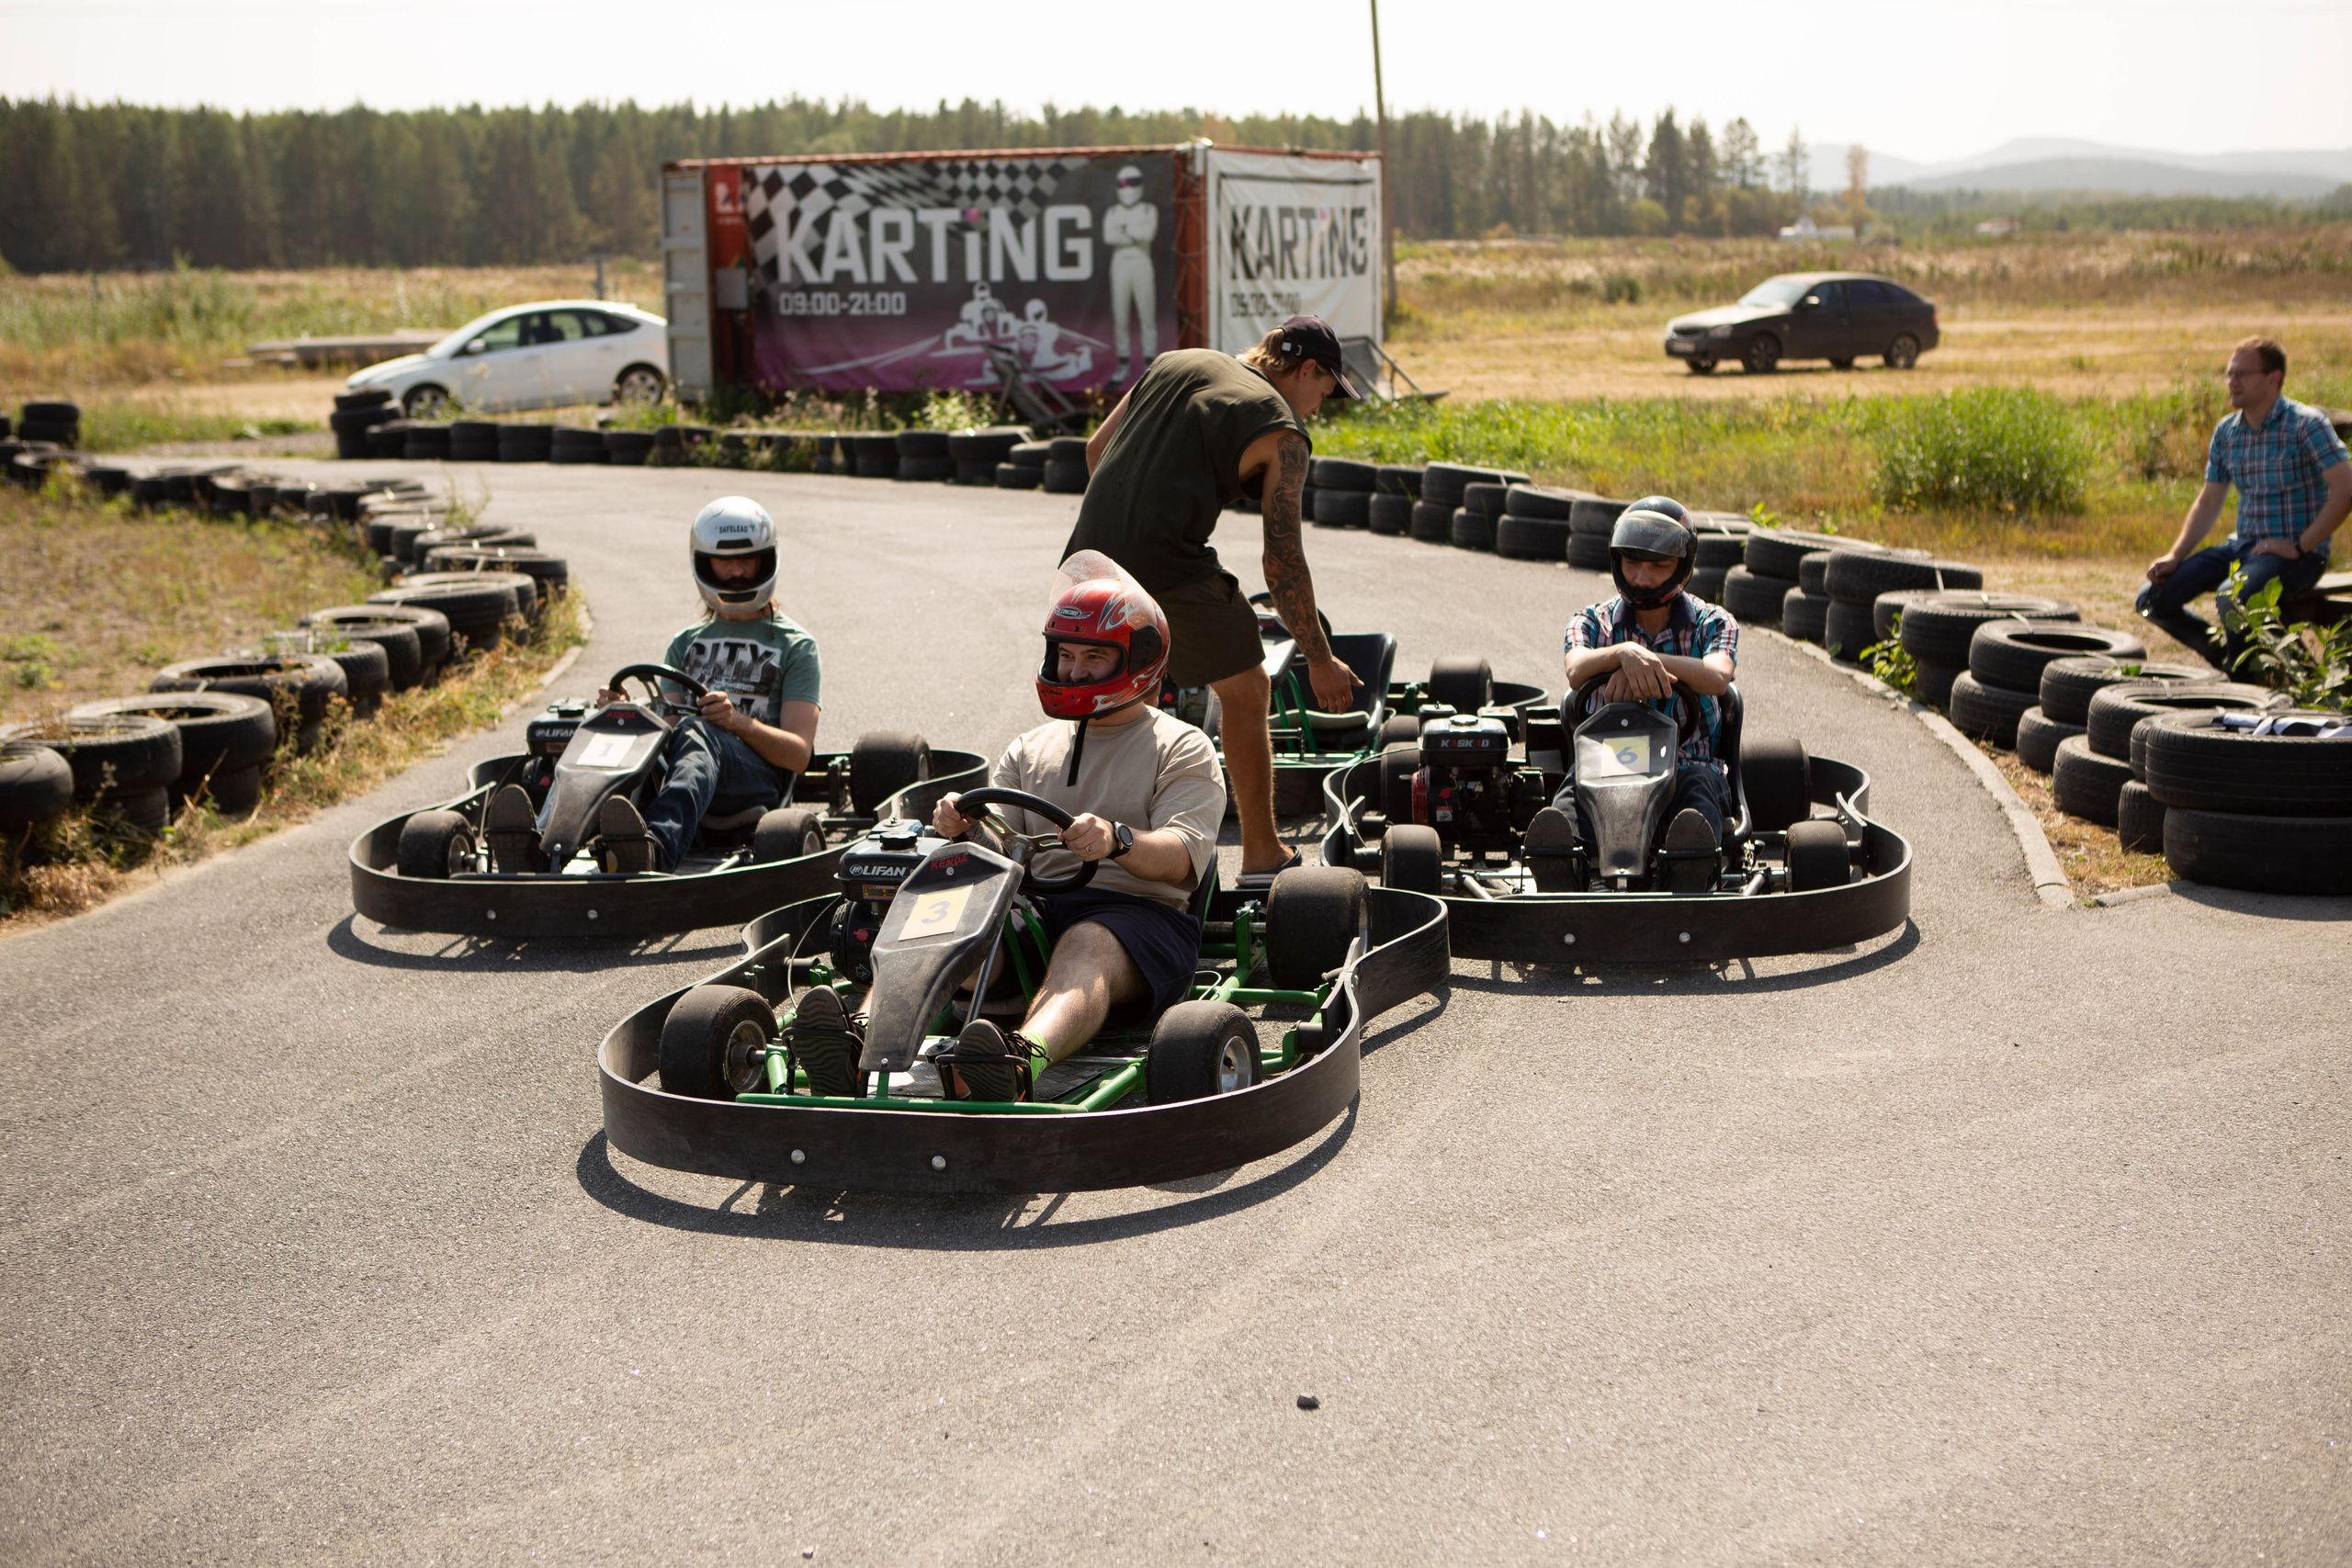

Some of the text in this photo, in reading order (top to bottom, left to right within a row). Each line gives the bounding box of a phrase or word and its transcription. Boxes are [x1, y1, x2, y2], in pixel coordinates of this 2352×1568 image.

[779, 292, 907, 315] 09:00-21:00
[719, 525, 749, 534] SAFELEAD
[681, 642, 776, 682] CITY
[607, 711, 636, 719] KENDA
[597, 742, 614, 757] 1
[1441, 739, 1490, 748] KASKAD
[1616, 746, 1638, 765] 6
[931, 854, 968, 870] KENDA
[862, 865, 907, 876] LIFAN
[921, 900, 951, 925] 3
